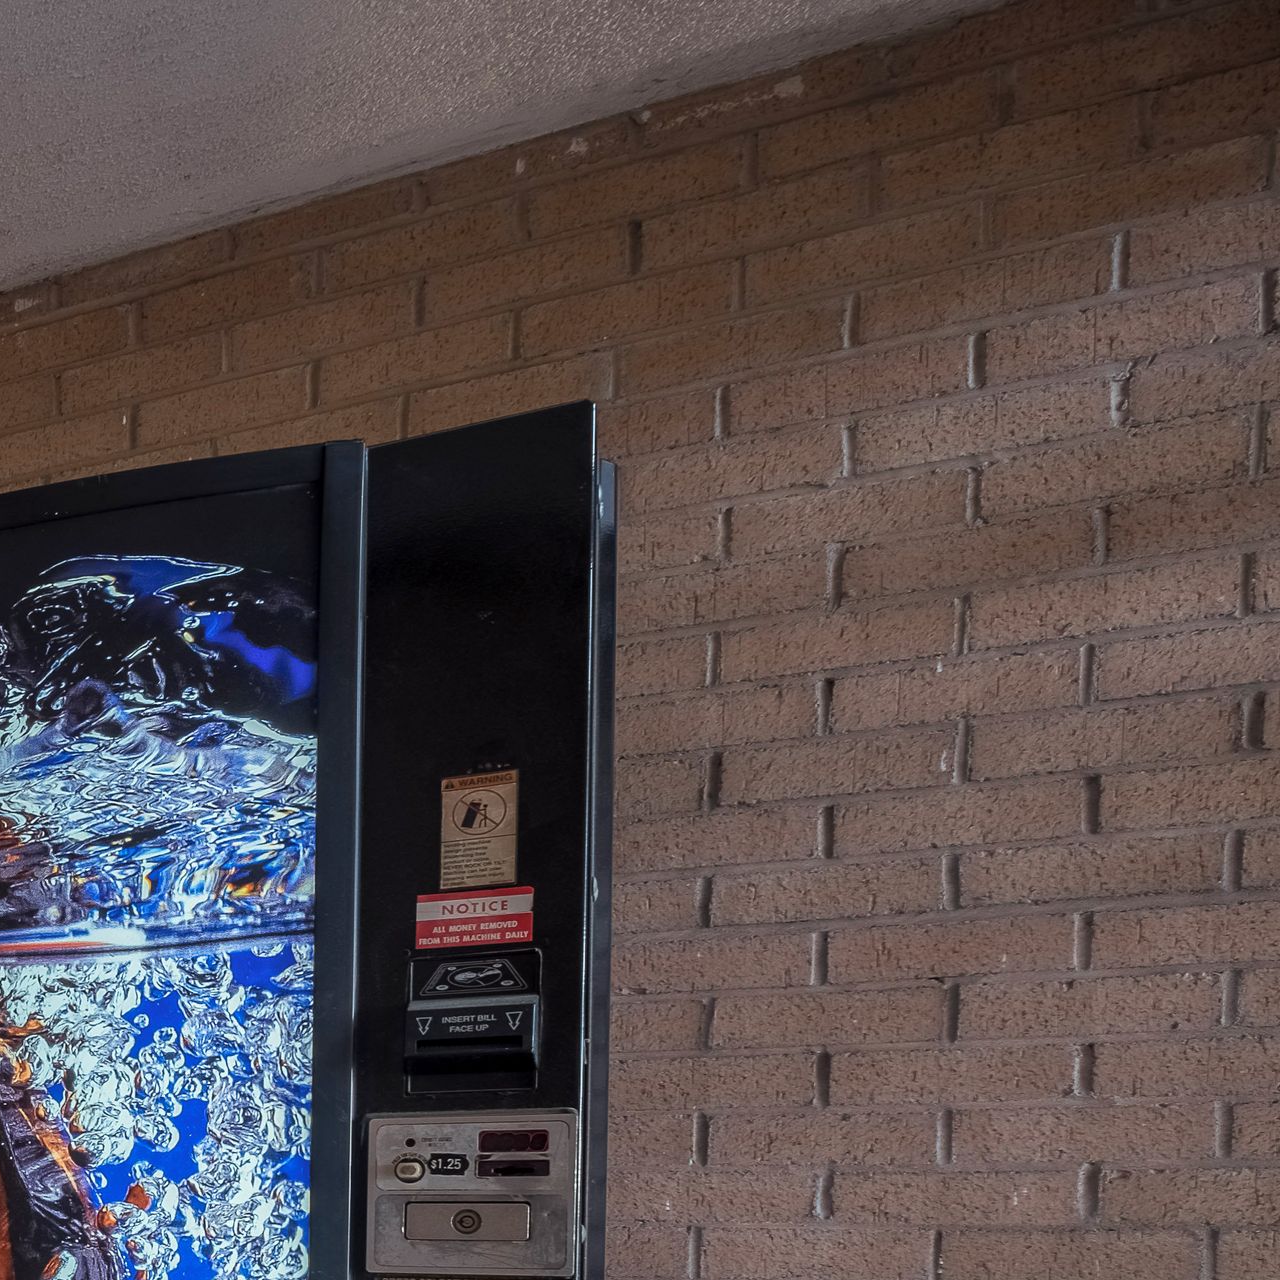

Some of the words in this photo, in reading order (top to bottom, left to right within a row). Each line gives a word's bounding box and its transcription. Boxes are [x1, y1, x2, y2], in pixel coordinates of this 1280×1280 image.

[458, 773, 513, 787] WARNING
[441, 900, 508, 915] NOTICE
[432, 926, 446, 934] ALL
[448, 923, 477, 933] MONEY
[480, 920, 518, 930] REMOVED
[443, 935, 460, 943] THIS
[462, 932, 501, 942] MACHINE
[505, 931, 529, 939] DAILY
[441, 1014, 475, 1024] INSERT
[477, 1014, 497, 1022] BILL
[449, 1024, 473, 1032] FACE
[475, 1024, 489, 1032] UP
[430, 1158, 461, 1170] $1.25
